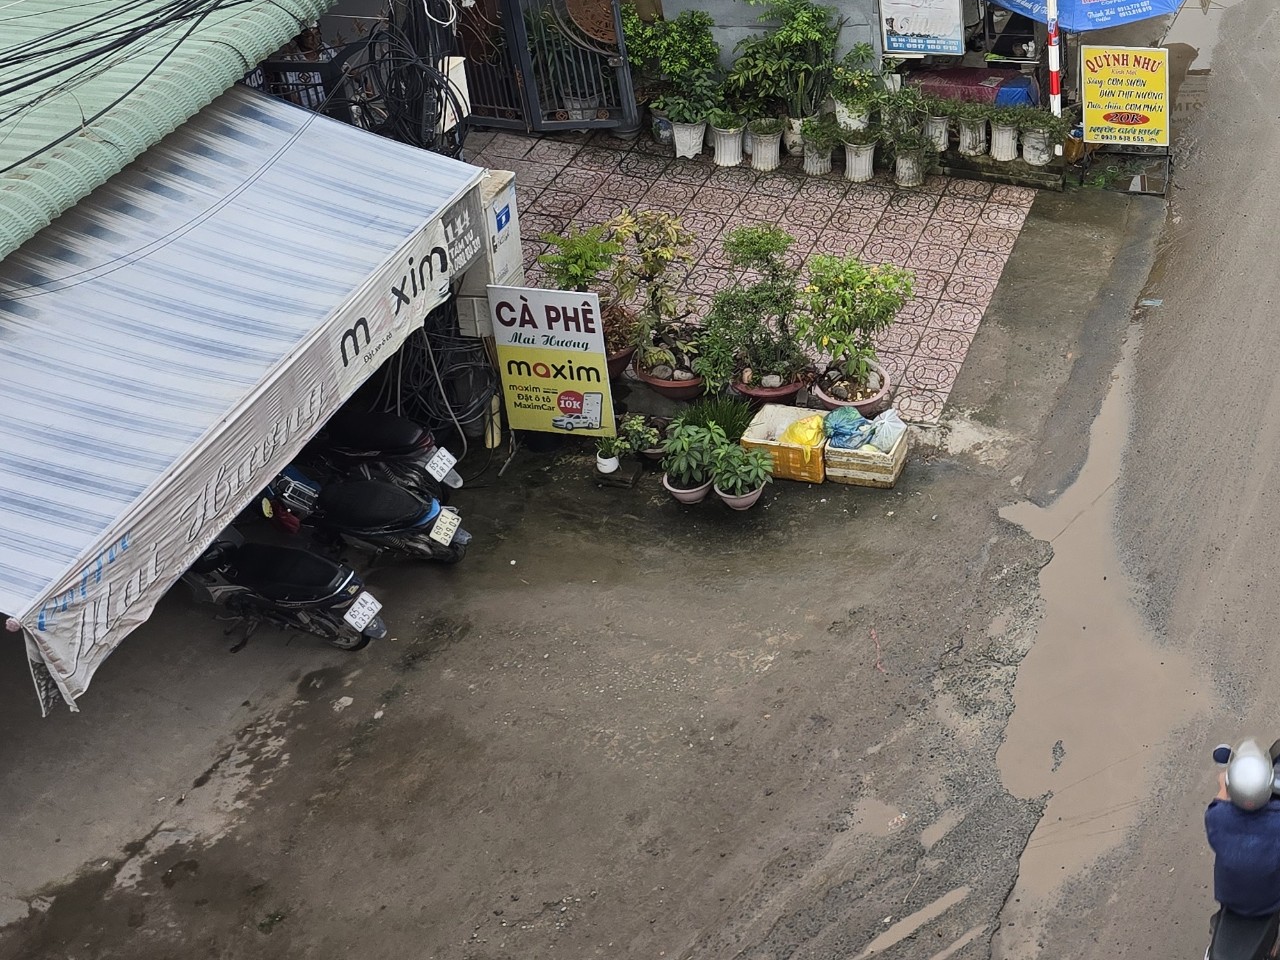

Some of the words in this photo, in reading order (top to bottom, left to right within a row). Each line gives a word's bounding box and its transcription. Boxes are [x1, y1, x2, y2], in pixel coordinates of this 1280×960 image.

[1085, 51, 1129, 73] QUỲNH
[1133, 55, 1162, 73] NHƯ
[1108, 113, 1143, 124] 20K
[445, 208, 471, 243] 144
[495, 295, 539, 330] CÀ
[544, 300, 596, 334] PHÊ
[507, 331, 536, 345] Mai
[541, 334, 590, 351] Hương
[507, 359, 601, 383] maxim
[509, 384, 541, 393] maxim
[517, 393, 533, 403] Đặt
[541, 395, 552, 403] tô
[513, 401, 555, 412] MaximCar
[560, 400, 581, 409] 10K
[349, 597, 368, 619] 65-AA
[355, 601, 379, 629] 035.97
